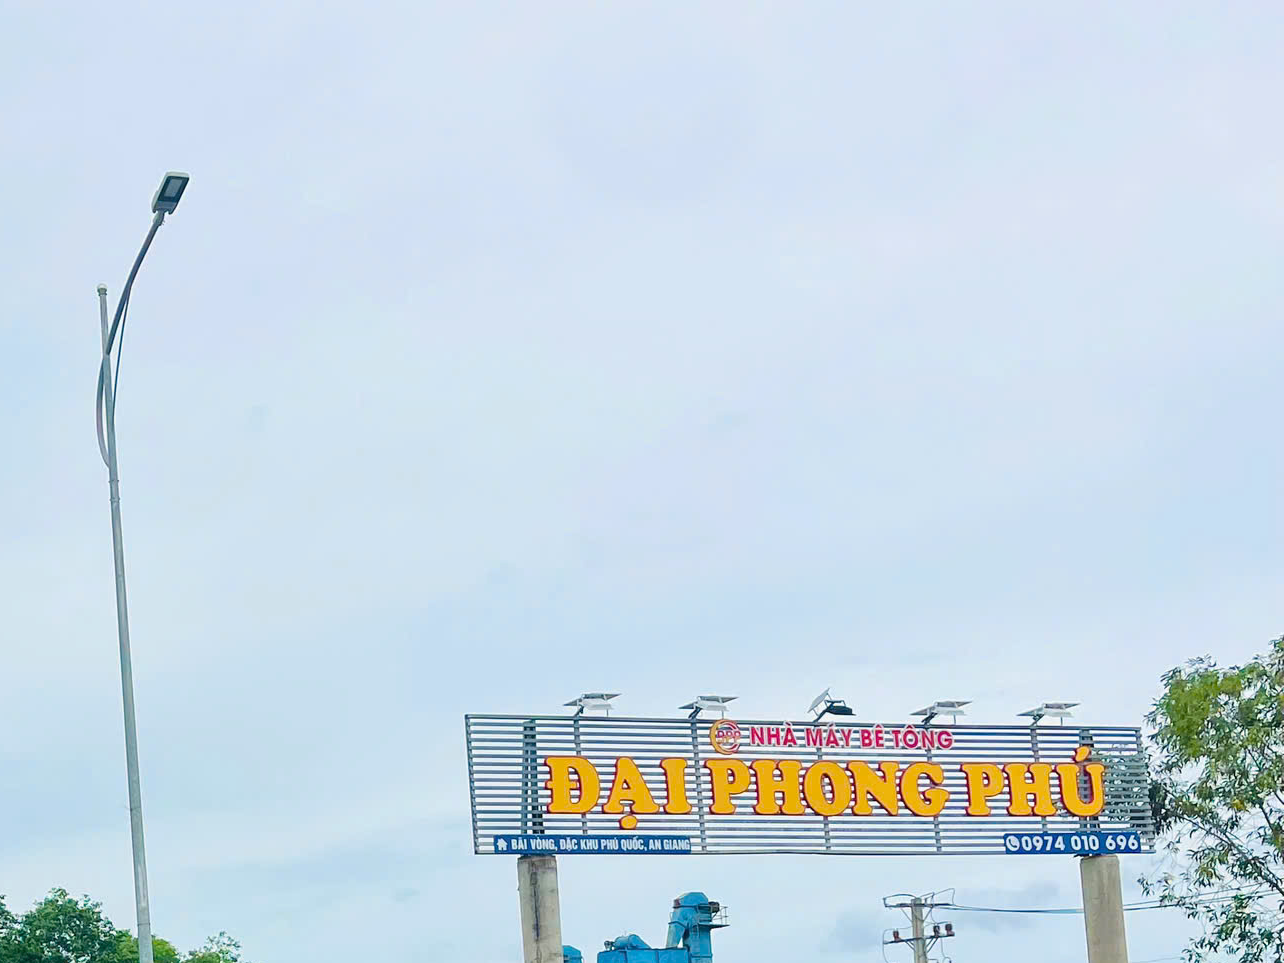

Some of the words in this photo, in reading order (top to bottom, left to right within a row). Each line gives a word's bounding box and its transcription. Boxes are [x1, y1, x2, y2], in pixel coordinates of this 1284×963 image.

[749, 720, 798, 747] NHÀ
[804, 722, 852, 748] MÁY
[860, 723, 885, 749] BÊ
[891, 724, 954, 750] TÔNG
[544, 756, 692, 830] ĐẠI
[704, 758, 950, 817] PHONG
[961, 745, 1106, 817] PHÚ
[530, 836, 558, 851] VÒNG,
[580, 838, 598, 850] KHU
[600, 837, 619, 850] PHÚ
[620, 836, 647, 851] QUỐC,
[648, 839, 662, 850] AN
[663, 839, 691, 850] GIANG
[1021, 835, 1065, 851] 0974
[1070, 835, 1099, 851] 010
[1105, 835, 1138, 850] 696
